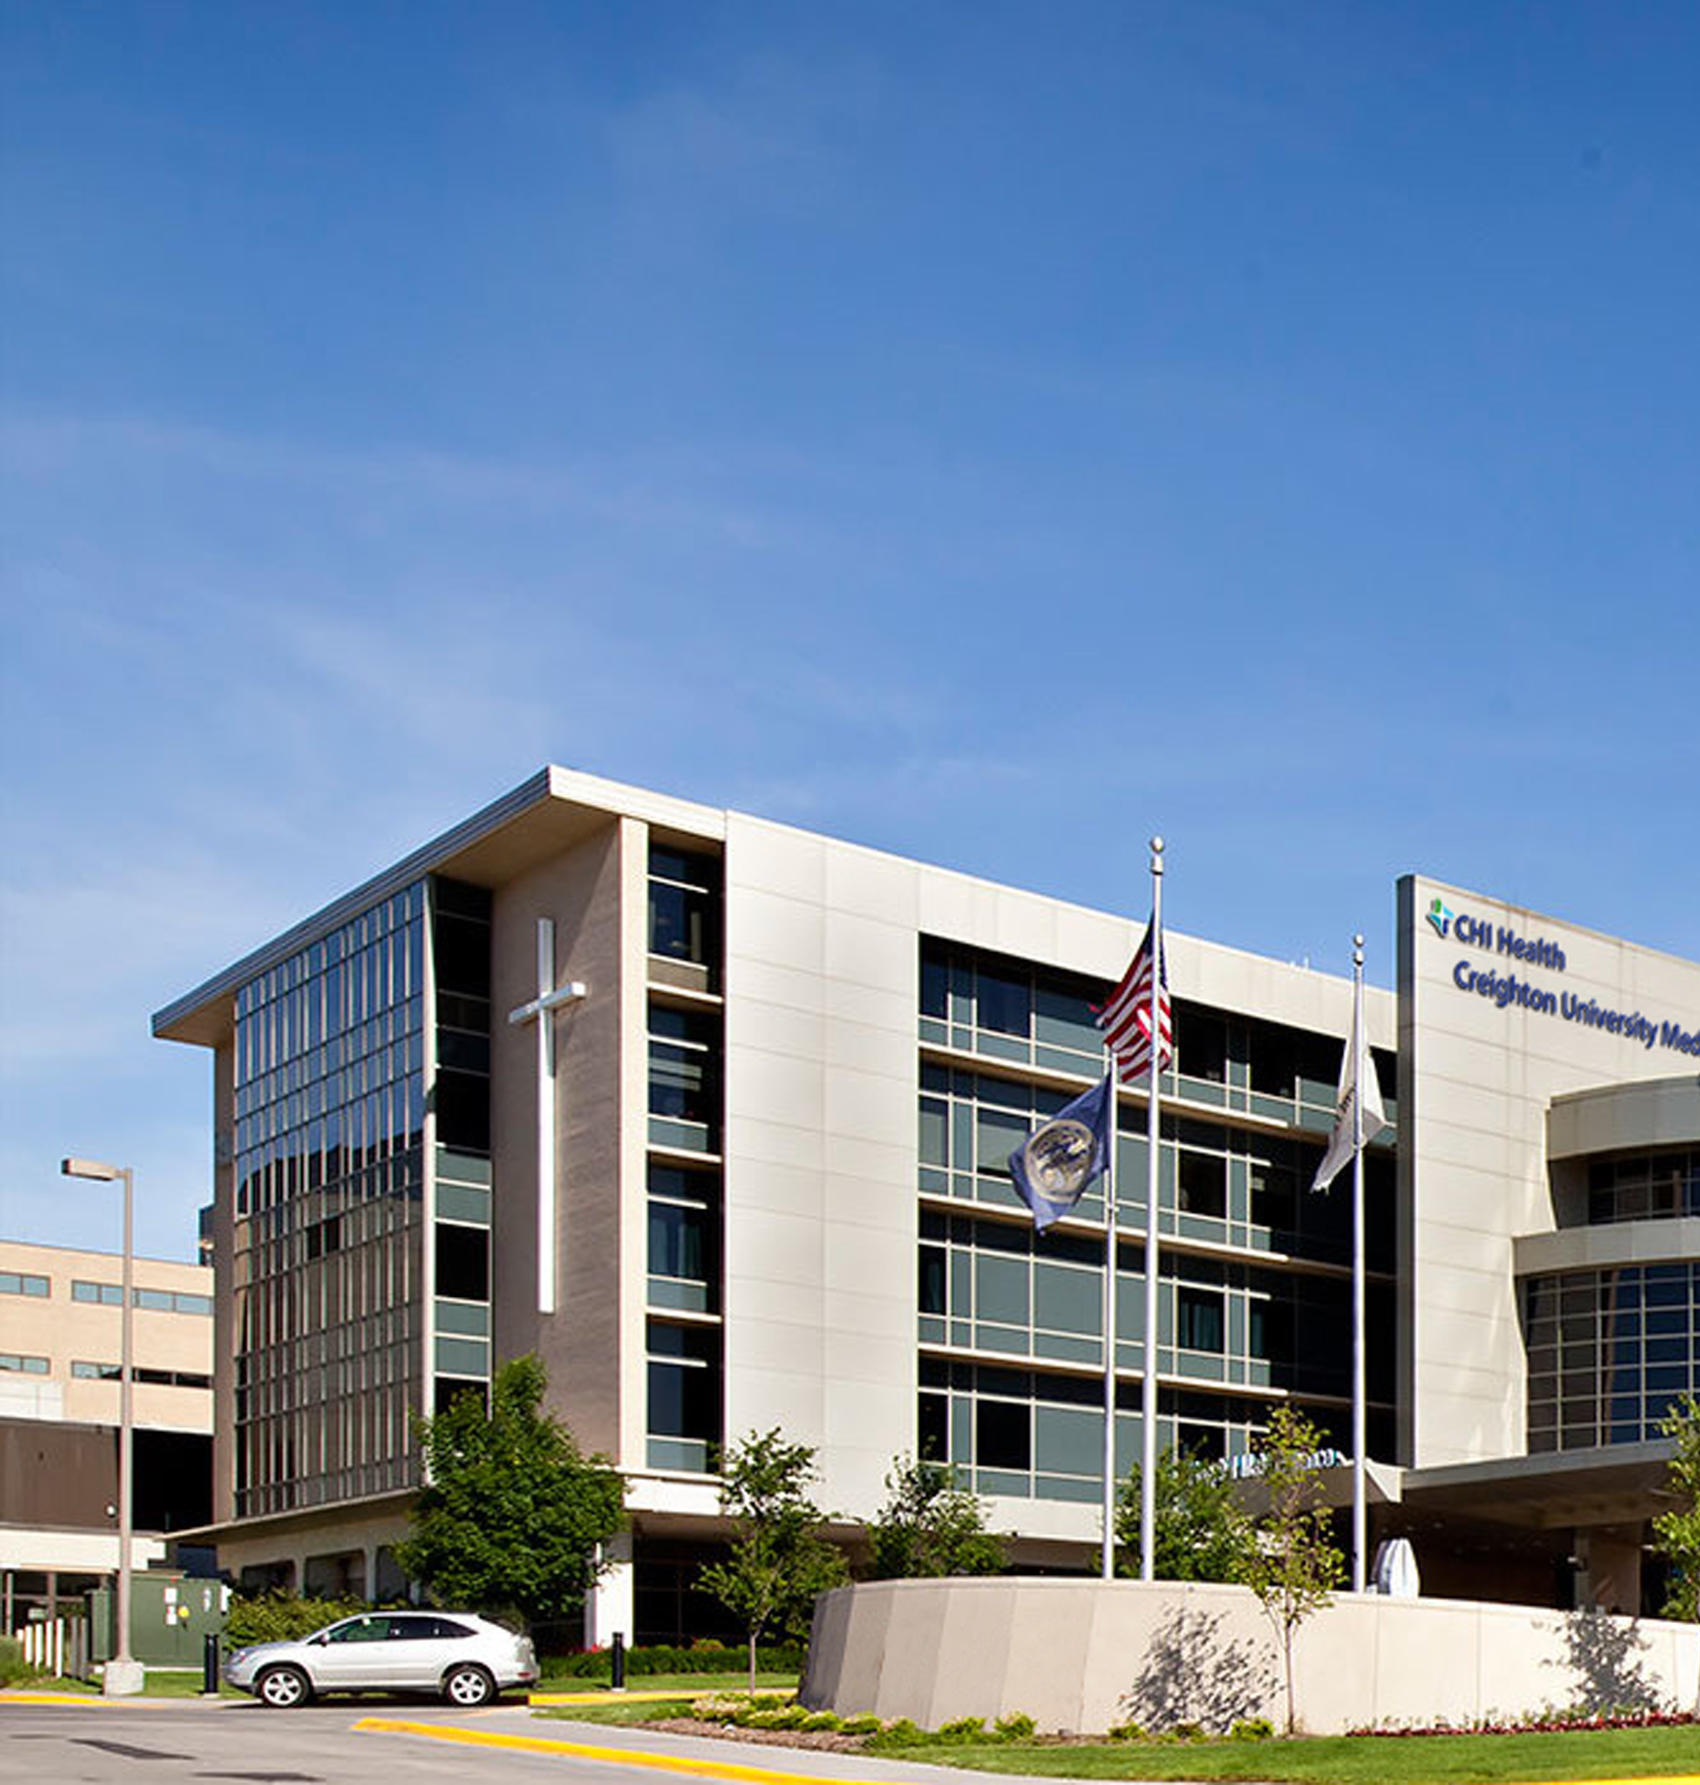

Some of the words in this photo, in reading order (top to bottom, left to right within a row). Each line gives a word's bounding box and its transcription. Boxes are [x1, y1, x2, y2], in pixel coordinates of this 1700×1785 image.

[1454, 914, 1493, 950] CHI
[1496, 925, 1567, 971] Health
[1453, 959, 1558, 1016] Creighton
[1560, 990, 1659, 1049] University
